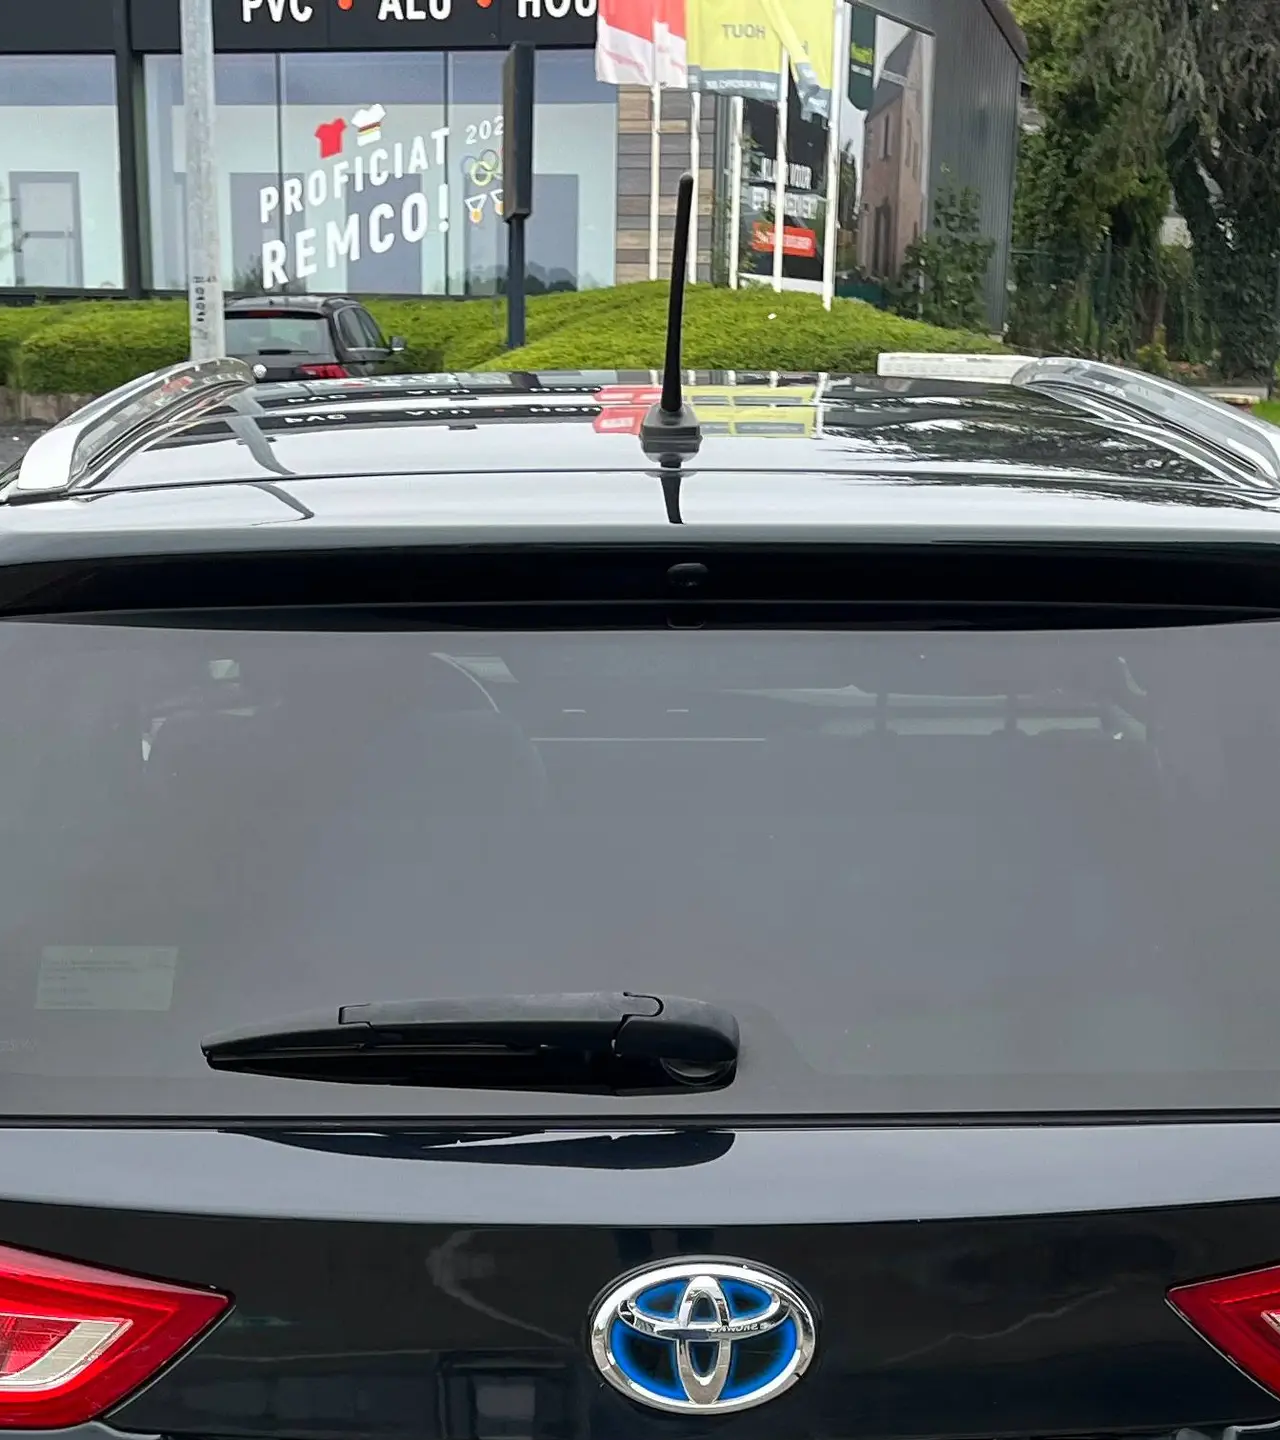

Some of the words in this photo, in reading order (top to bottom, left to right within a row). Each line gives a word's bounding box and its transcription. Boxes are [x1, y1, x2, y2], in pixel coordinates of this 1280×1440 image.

[241, 0, 314, 22] PVC
[377, 0, 451, 21] ALU
[517, 0, 596, 18] HOU
[465, 115, 504, 144] 202
[260, 127, 449, 223] PROFICIAT
[261, 183, 449, 289] REMCO!
